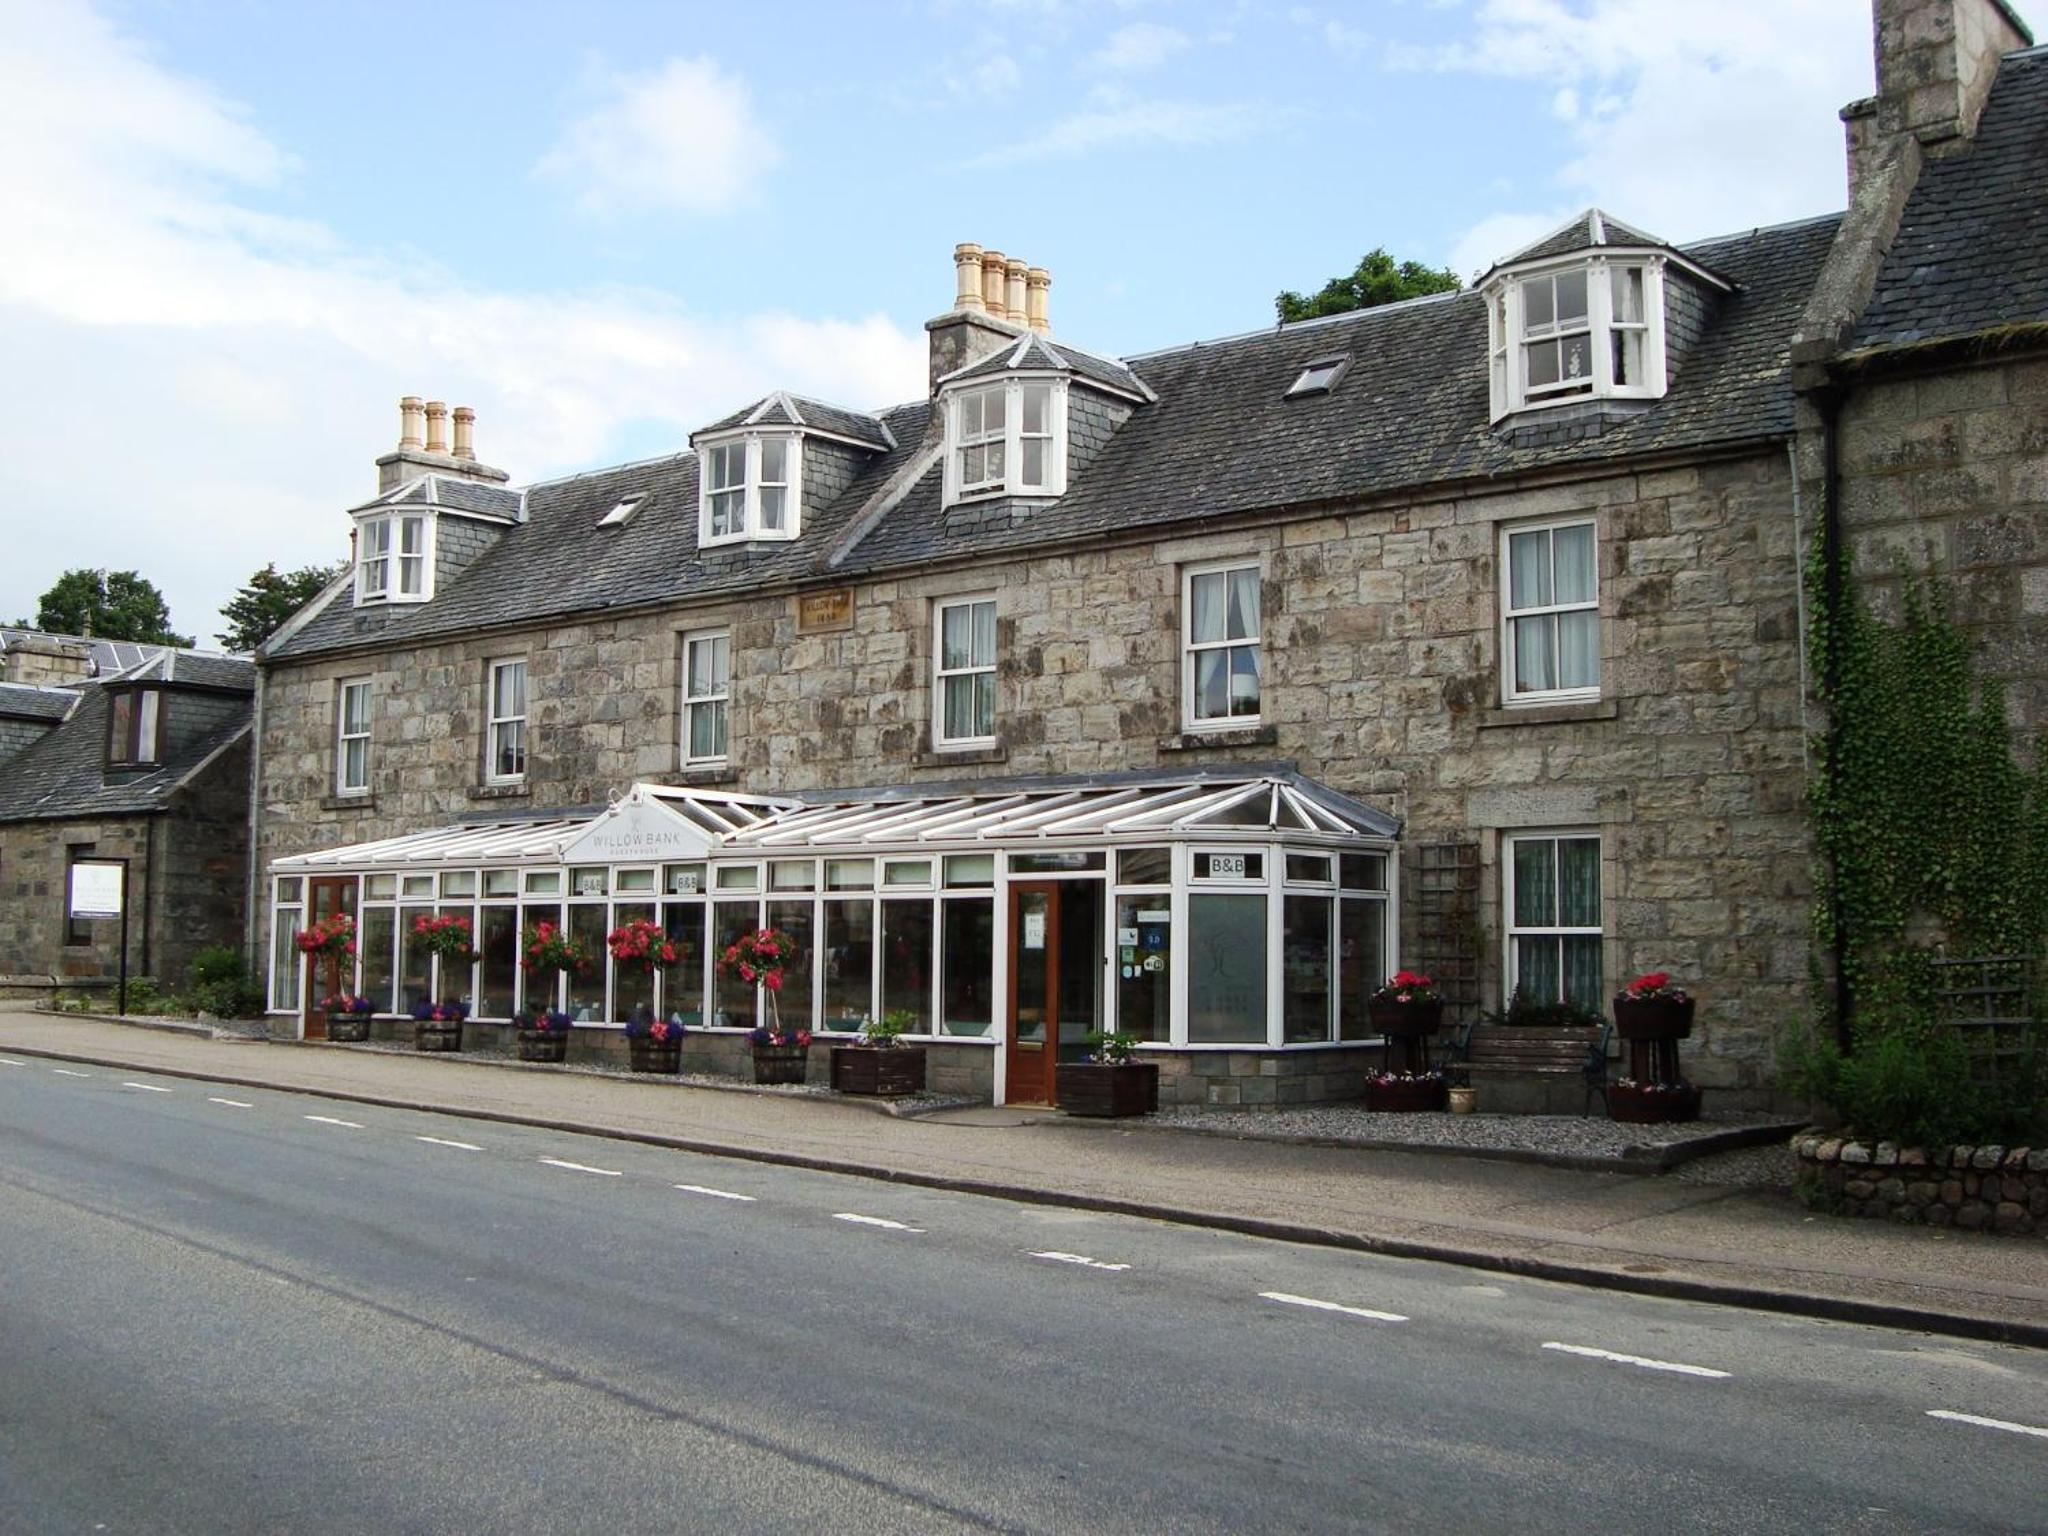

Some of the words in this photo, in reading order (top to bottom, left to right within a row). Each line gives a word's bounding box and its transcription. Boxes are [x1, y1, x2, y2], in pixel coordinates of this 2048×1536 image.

[593, 832, 642, 847] WILLOW
[646, 831, 680, 846] BANK
[1212, 858, 1244, 872] B&B
[583, 878, 602, 891] B&B
[678, 876, 697, 889] B&B
